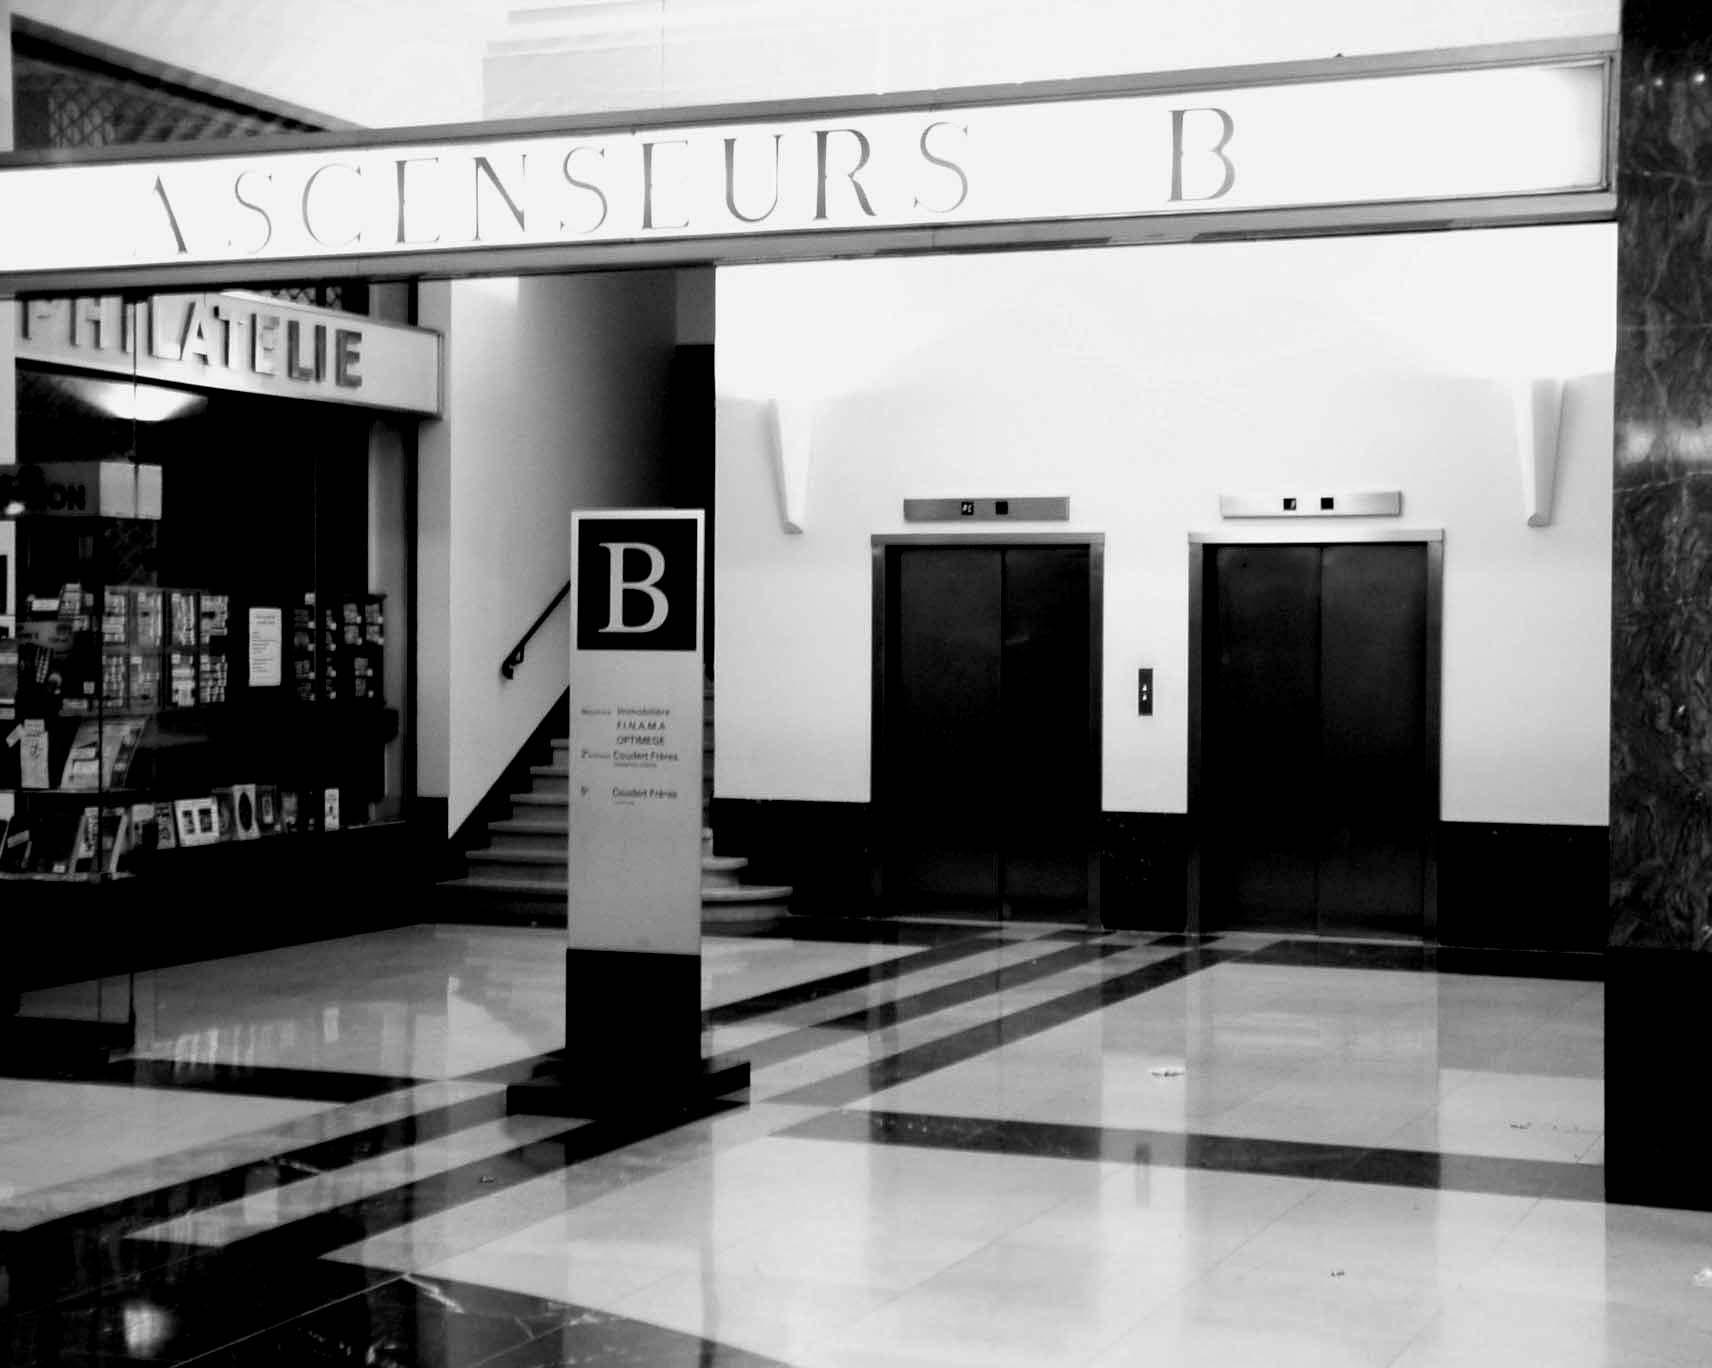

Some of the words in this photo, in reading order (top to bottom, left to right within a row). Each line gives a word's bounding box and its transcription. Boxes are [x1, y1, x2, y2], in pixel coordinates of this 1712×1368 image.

[133, 120, 969, 255] ASCENSEURS
[1167, 107, 1235, 203] B
[21, 295, 363, 388] PHILATELIE
[598, 541, 669, 633] B
